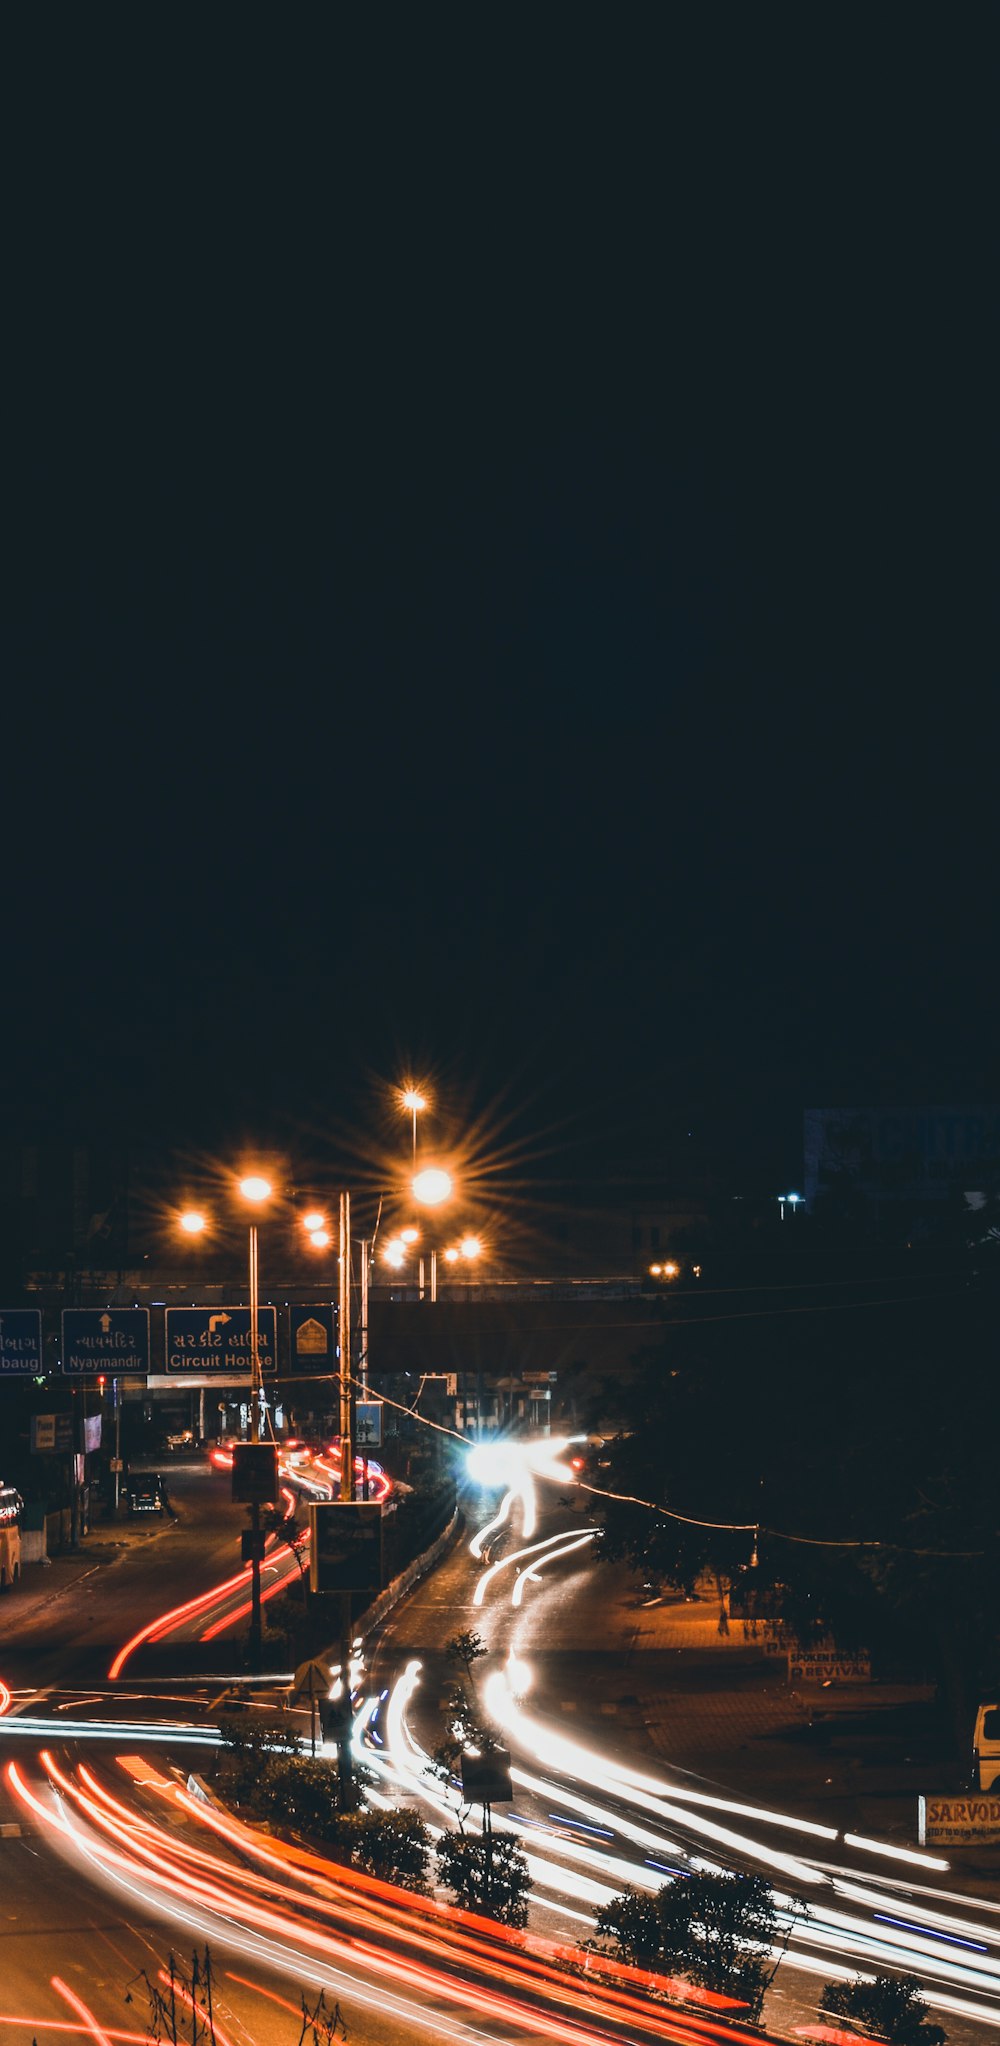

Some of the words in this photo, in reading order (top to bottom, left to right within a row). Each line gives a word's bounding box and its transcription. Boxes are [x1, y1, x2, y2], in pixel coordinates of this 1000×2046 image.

[69, 1354, 142, 1371] Nyaymandir
[170, 1353, 220, 1367] Circuit
[225, 1353, 273, 1367] House
[790, 1653, 829, 1662] SPOKEN
[805, 1667, 868, 1677] REVIVAL
